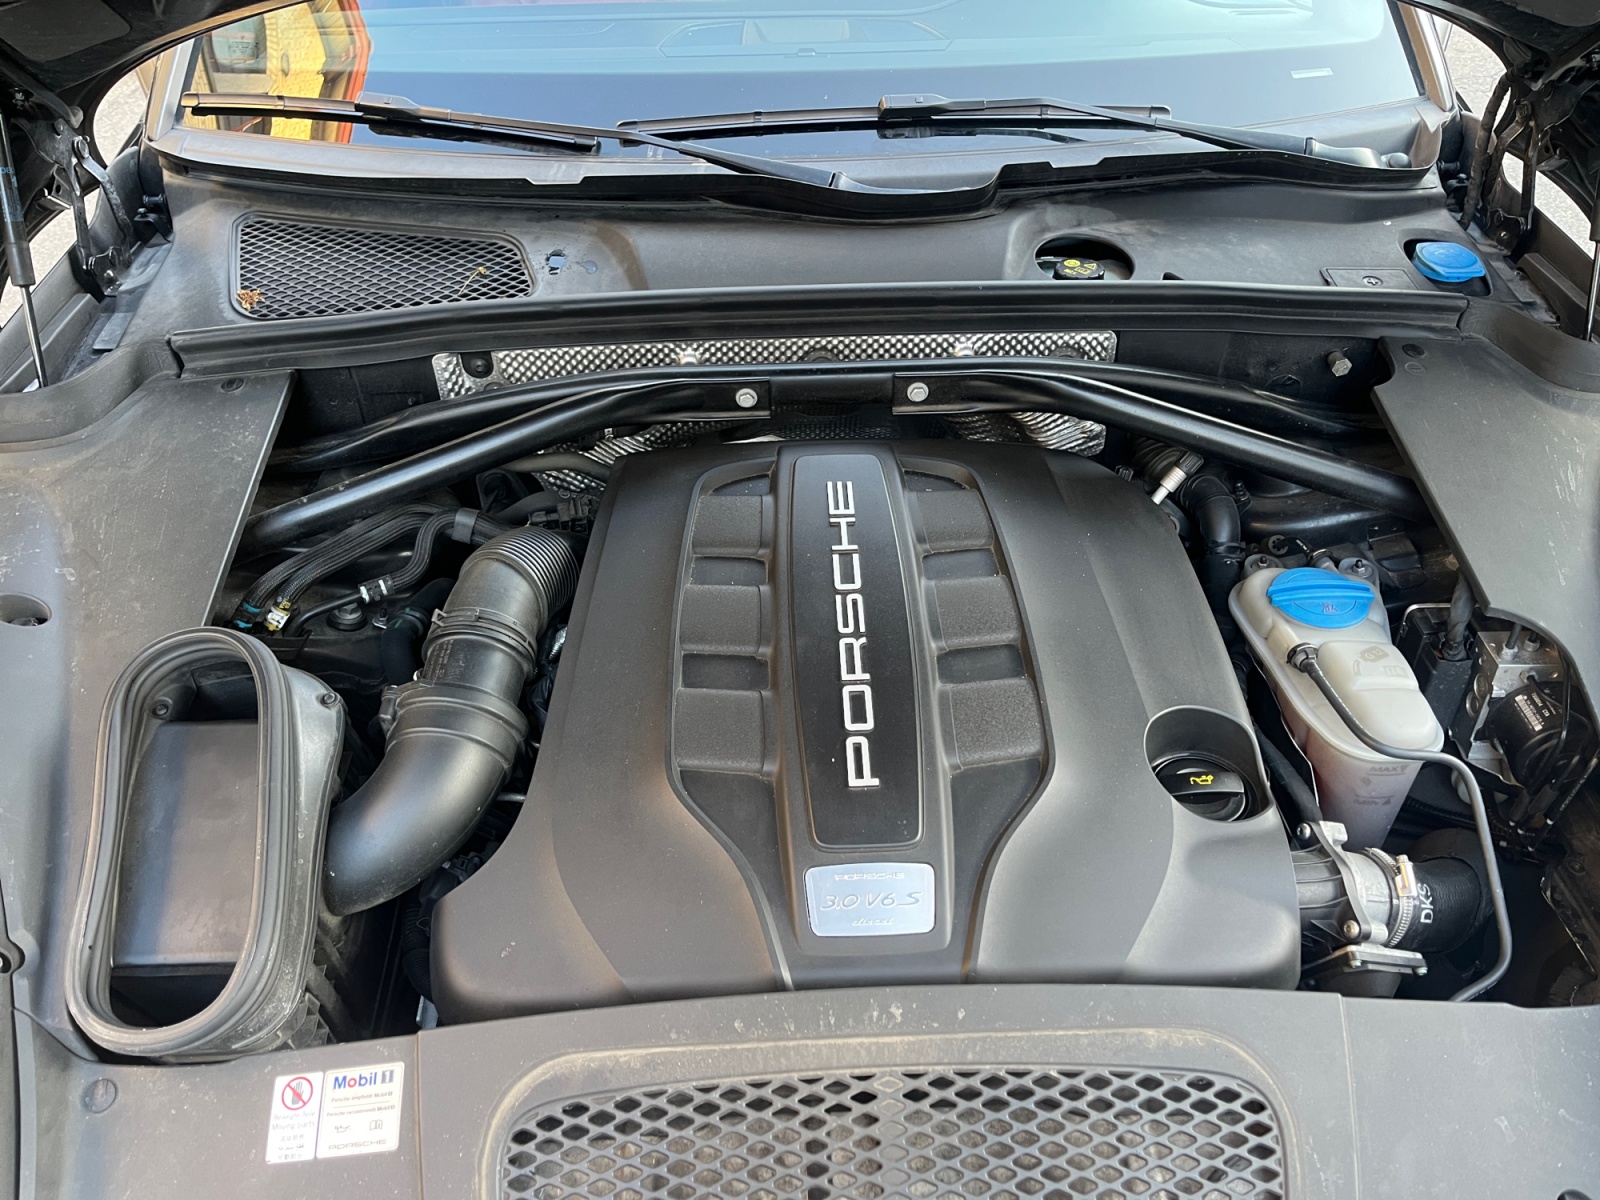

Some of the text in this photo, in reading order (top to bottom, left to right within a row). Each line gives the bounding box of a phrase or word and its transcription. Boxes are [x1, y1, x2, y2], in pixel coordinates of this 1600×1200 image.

[827, 481, 880, 788] PORSCHE
[834, 872, 905, 881] PORSCHE
[820, 891, 923, 911] 3.0 V6 S
[1417, 883, 1434, 924] DKS
[333, 1069, 395, 1090] Mobil 1
[271, 1122, 295, 1131] Moving
[328, 1139, 387, 1150] PORSCHE
